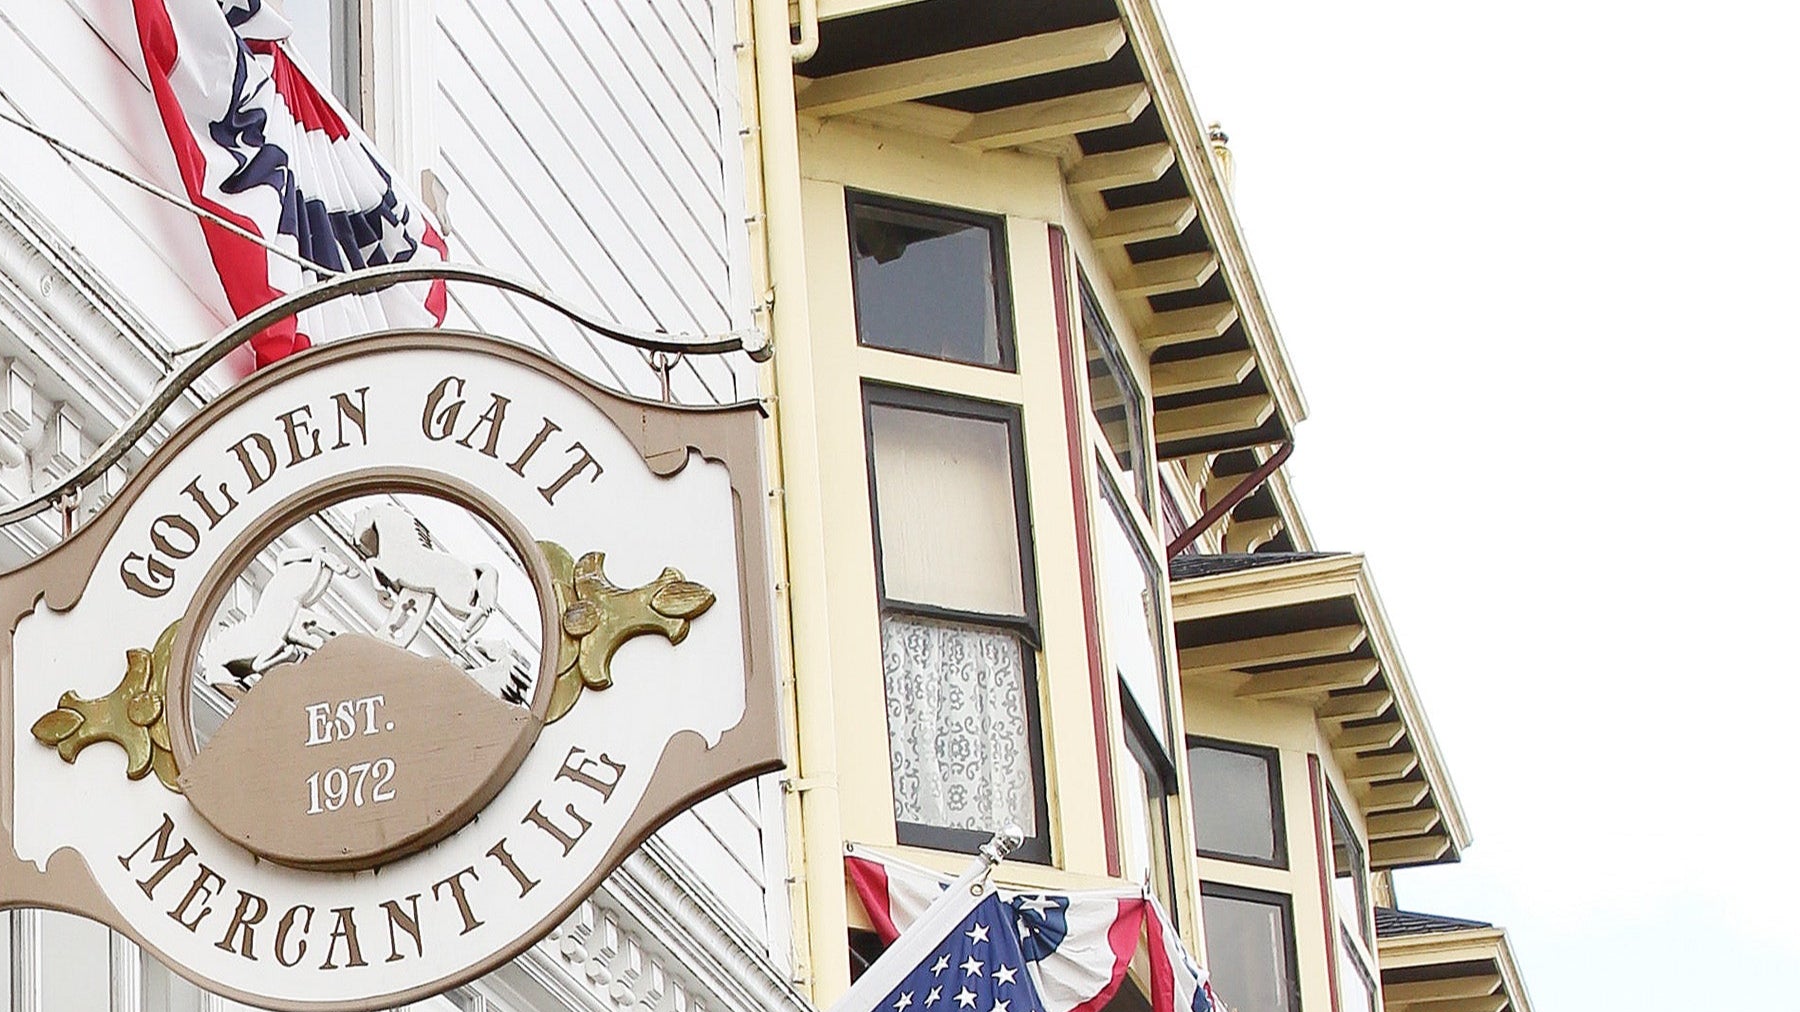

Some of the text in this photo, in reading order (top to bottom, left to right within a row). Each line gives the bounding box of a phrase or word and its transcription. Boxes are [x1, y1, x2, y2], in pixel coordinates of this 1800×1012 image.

[119, 375, 605, 599] GOLDEN GAIT
[304, 695, 396, 747] EST.
[304, 758, 398, 816] 1972
[116, 744, 628, 971] MERCANTILE
